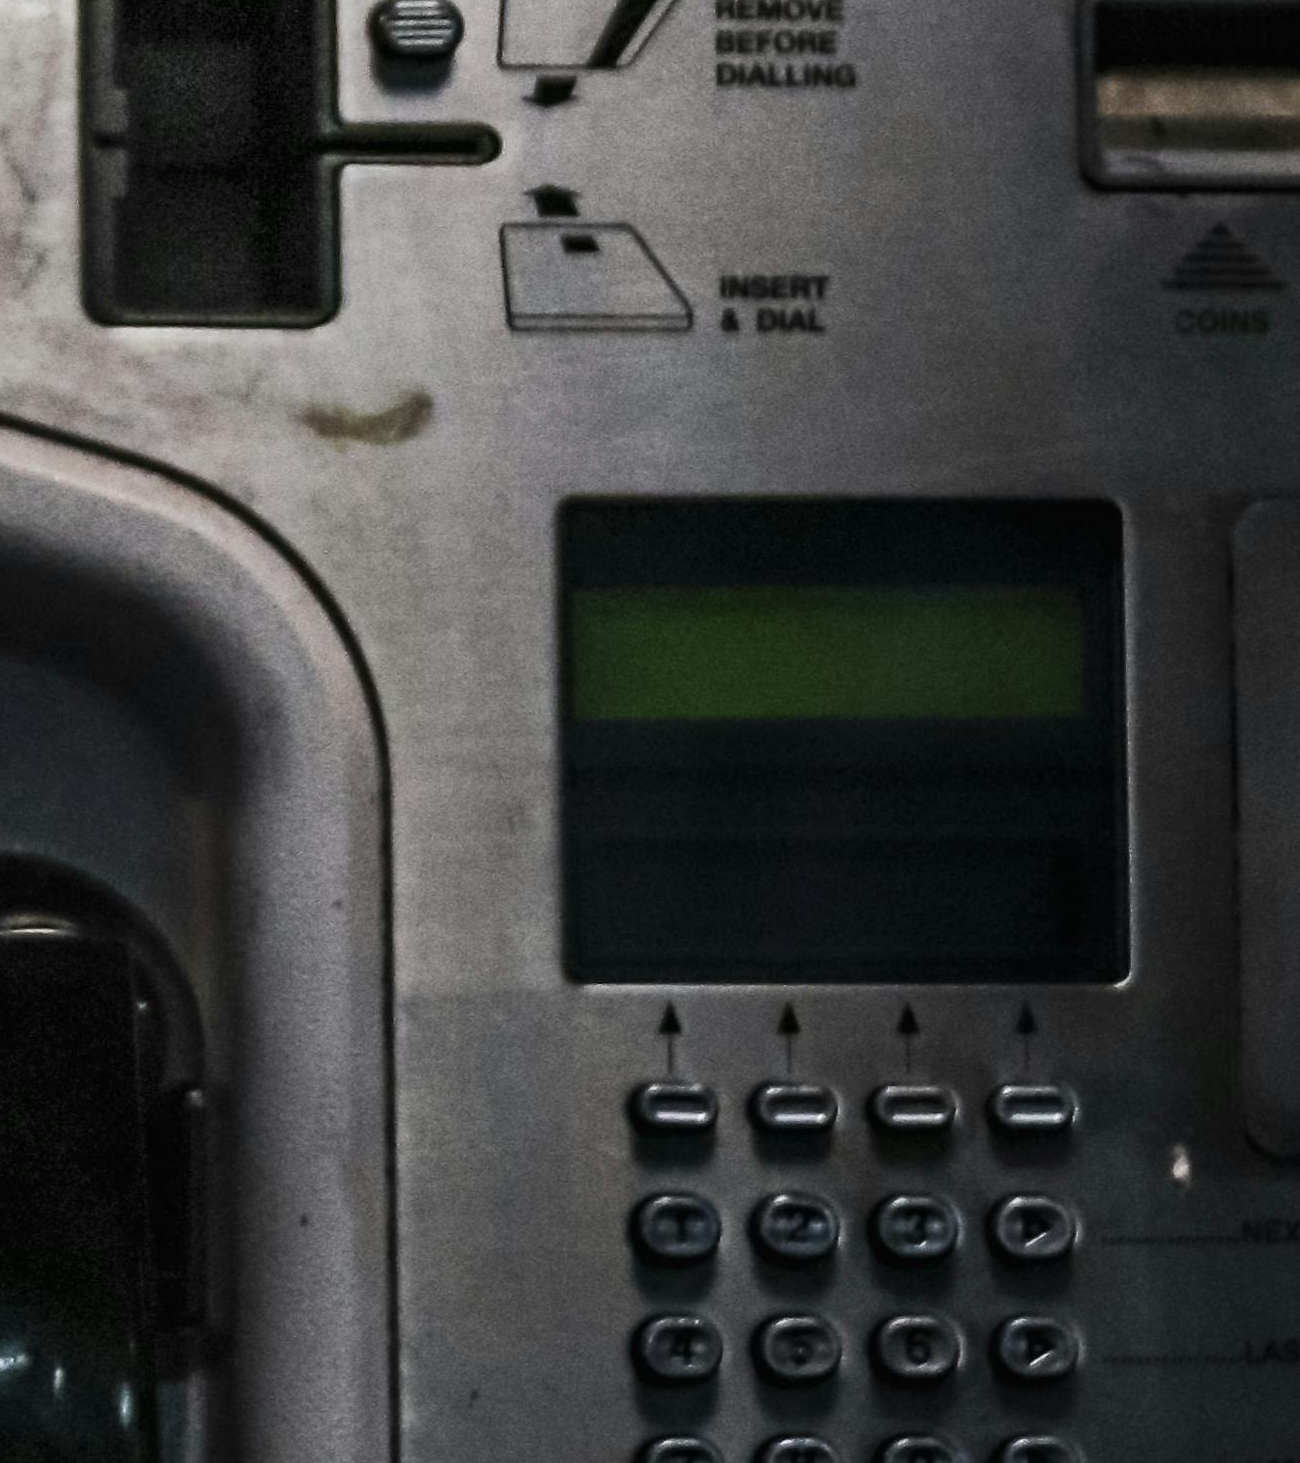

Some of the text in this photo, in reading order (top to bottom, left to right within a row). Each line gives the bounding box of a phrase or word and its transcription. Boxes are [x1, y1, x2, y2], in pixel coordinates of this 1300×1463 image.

[714, 29, 837, 55] BEFORE
[715, 61, 856, 88] DIALLING
[719, 275, 829, 299] INSERT
[756, 307, 825, 333] DIAL
[1174, 308, 1270, 335] COINS
